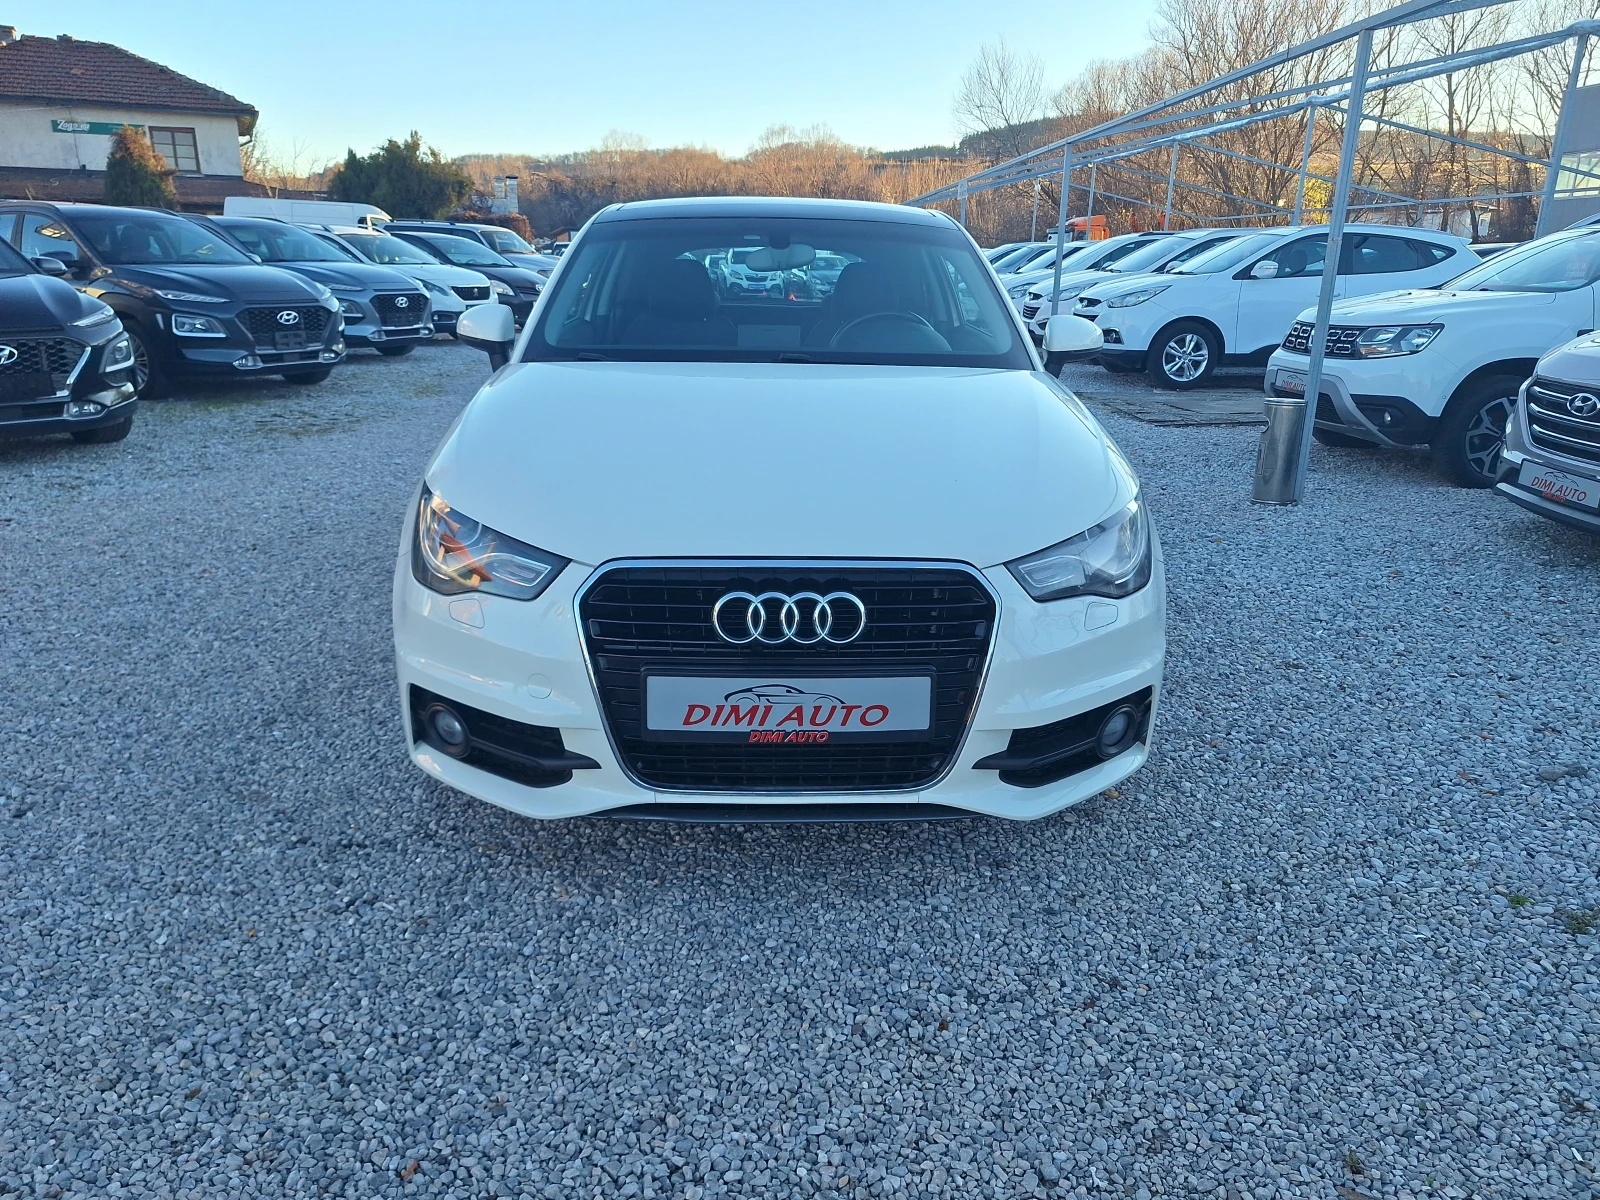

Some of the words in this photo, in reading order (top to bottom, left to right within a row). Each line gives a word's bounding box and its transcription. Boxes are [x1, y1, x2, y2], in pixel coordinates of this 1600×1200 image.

[57, 119, 90, 133] Zagoka
[1531, 476, 1556, 491] DIMI
[1553, 484, 1587, 502] AUTO
[682, 704, 773, 727] DIMI
[775, 704, 890, 727] AUTO
[748, 731, 785, 743] DIMI
[784, 731, 830, 743] AUTO
